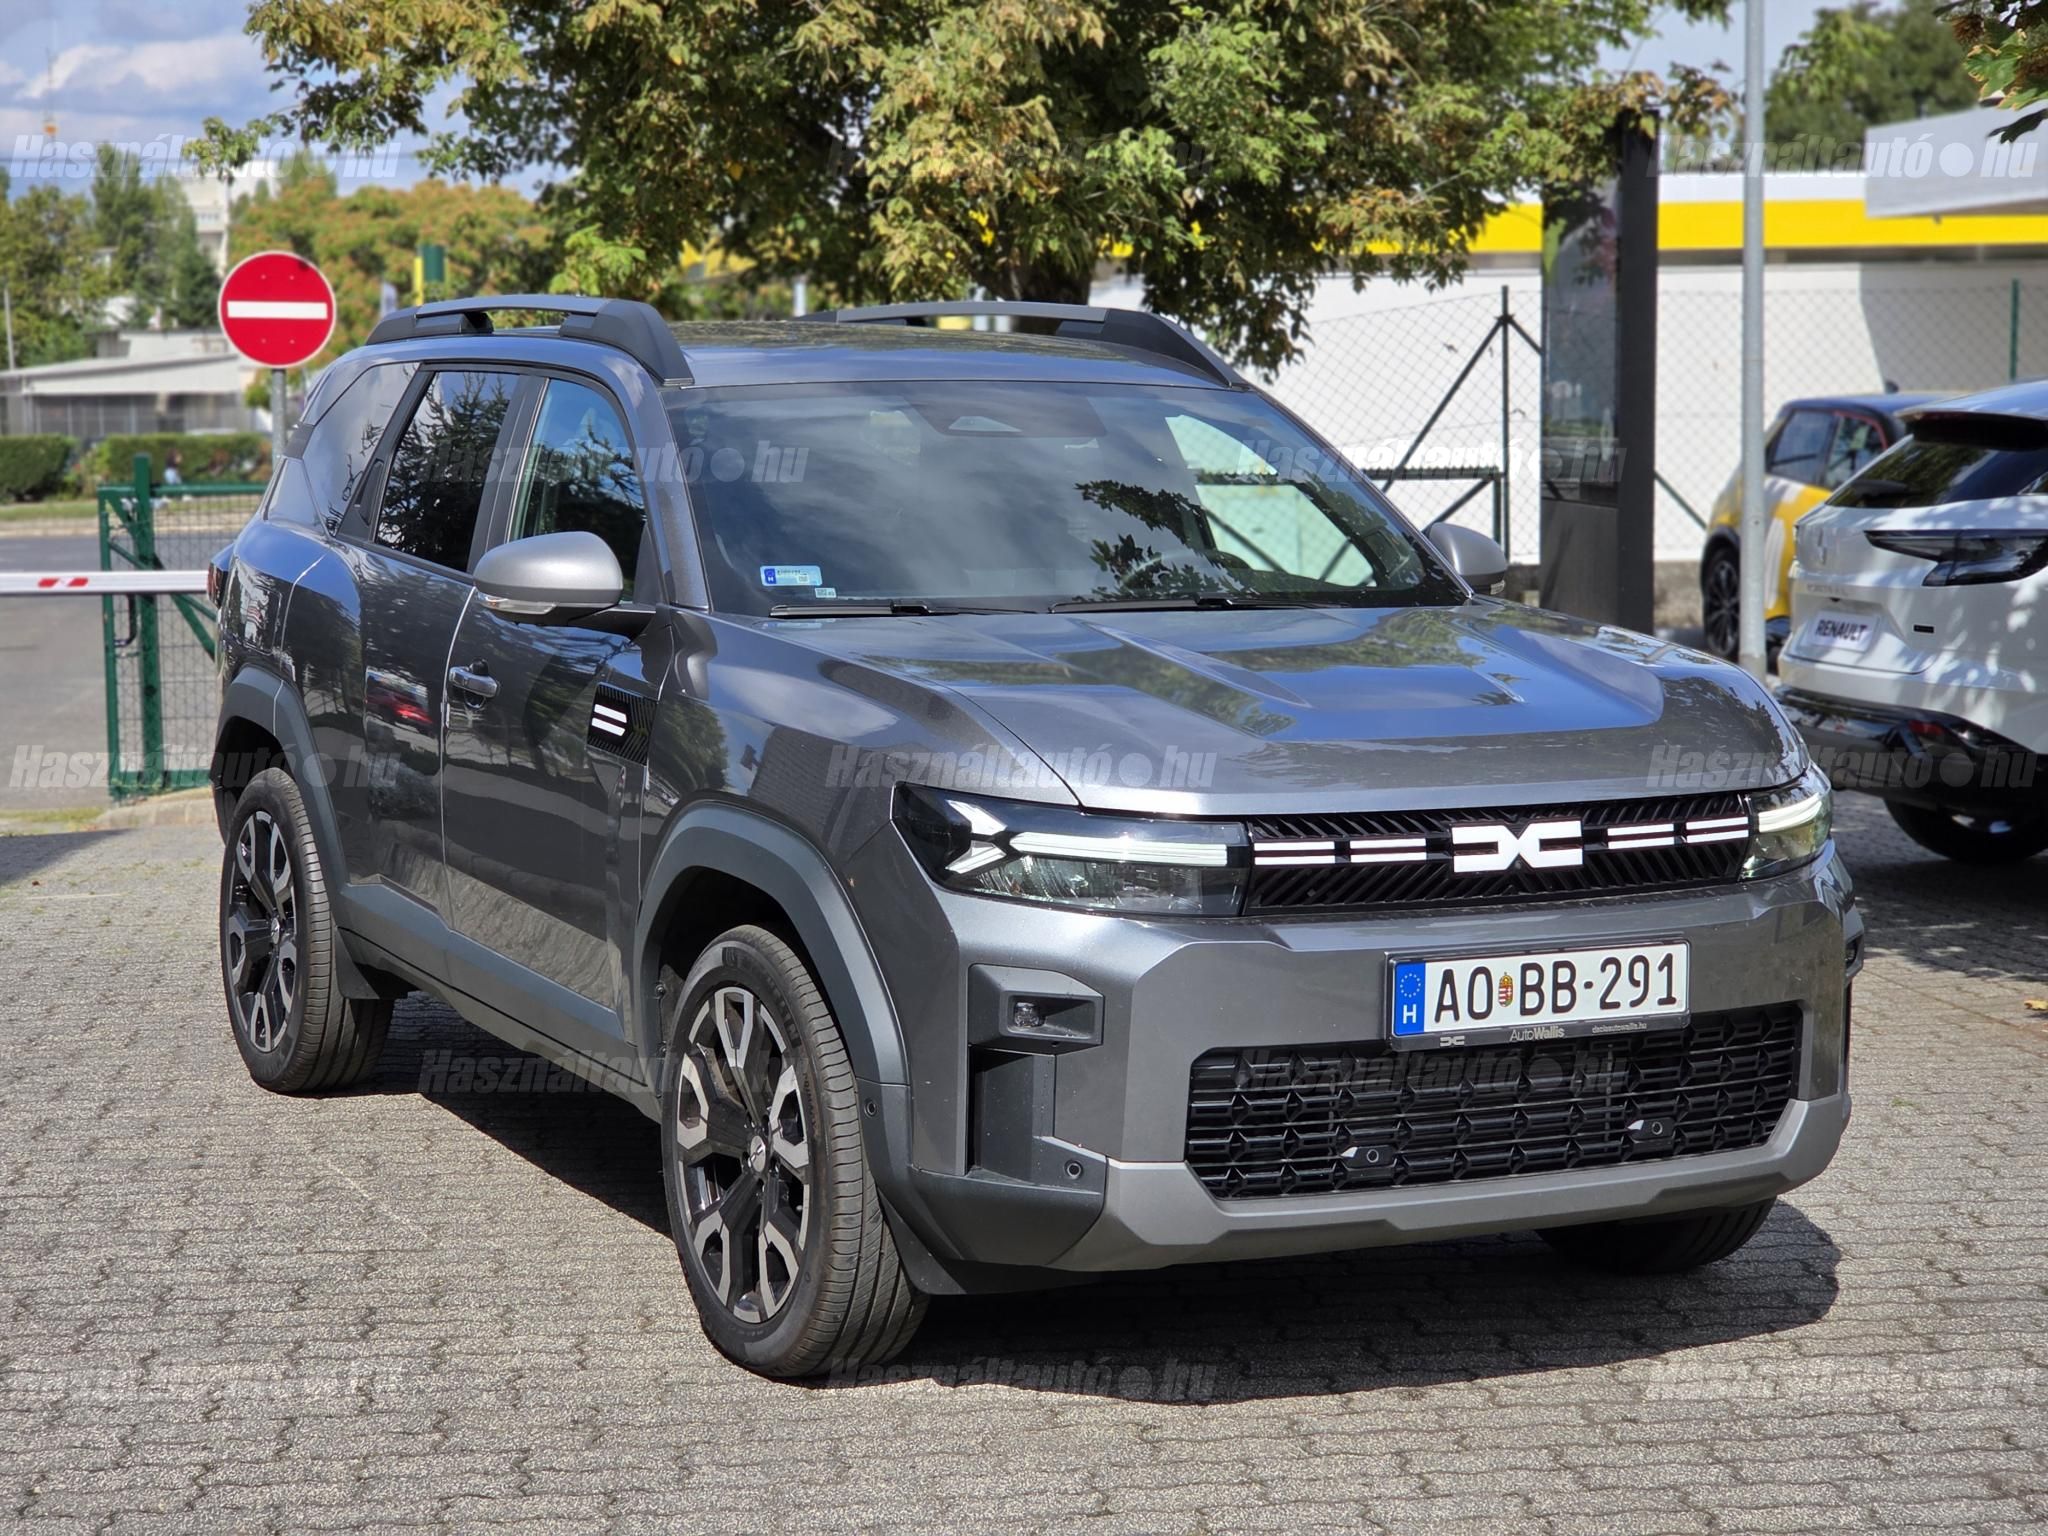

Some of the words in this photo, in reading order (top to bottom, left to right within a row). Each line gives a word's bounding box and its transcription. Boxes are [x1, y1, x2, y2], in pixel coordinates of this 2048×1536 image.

[1816, 619, 1867, 641] RENAULT
[1402, 1004, 1417, 1025] H
[1509, 1025, 1565, 1042] AutoWallis
